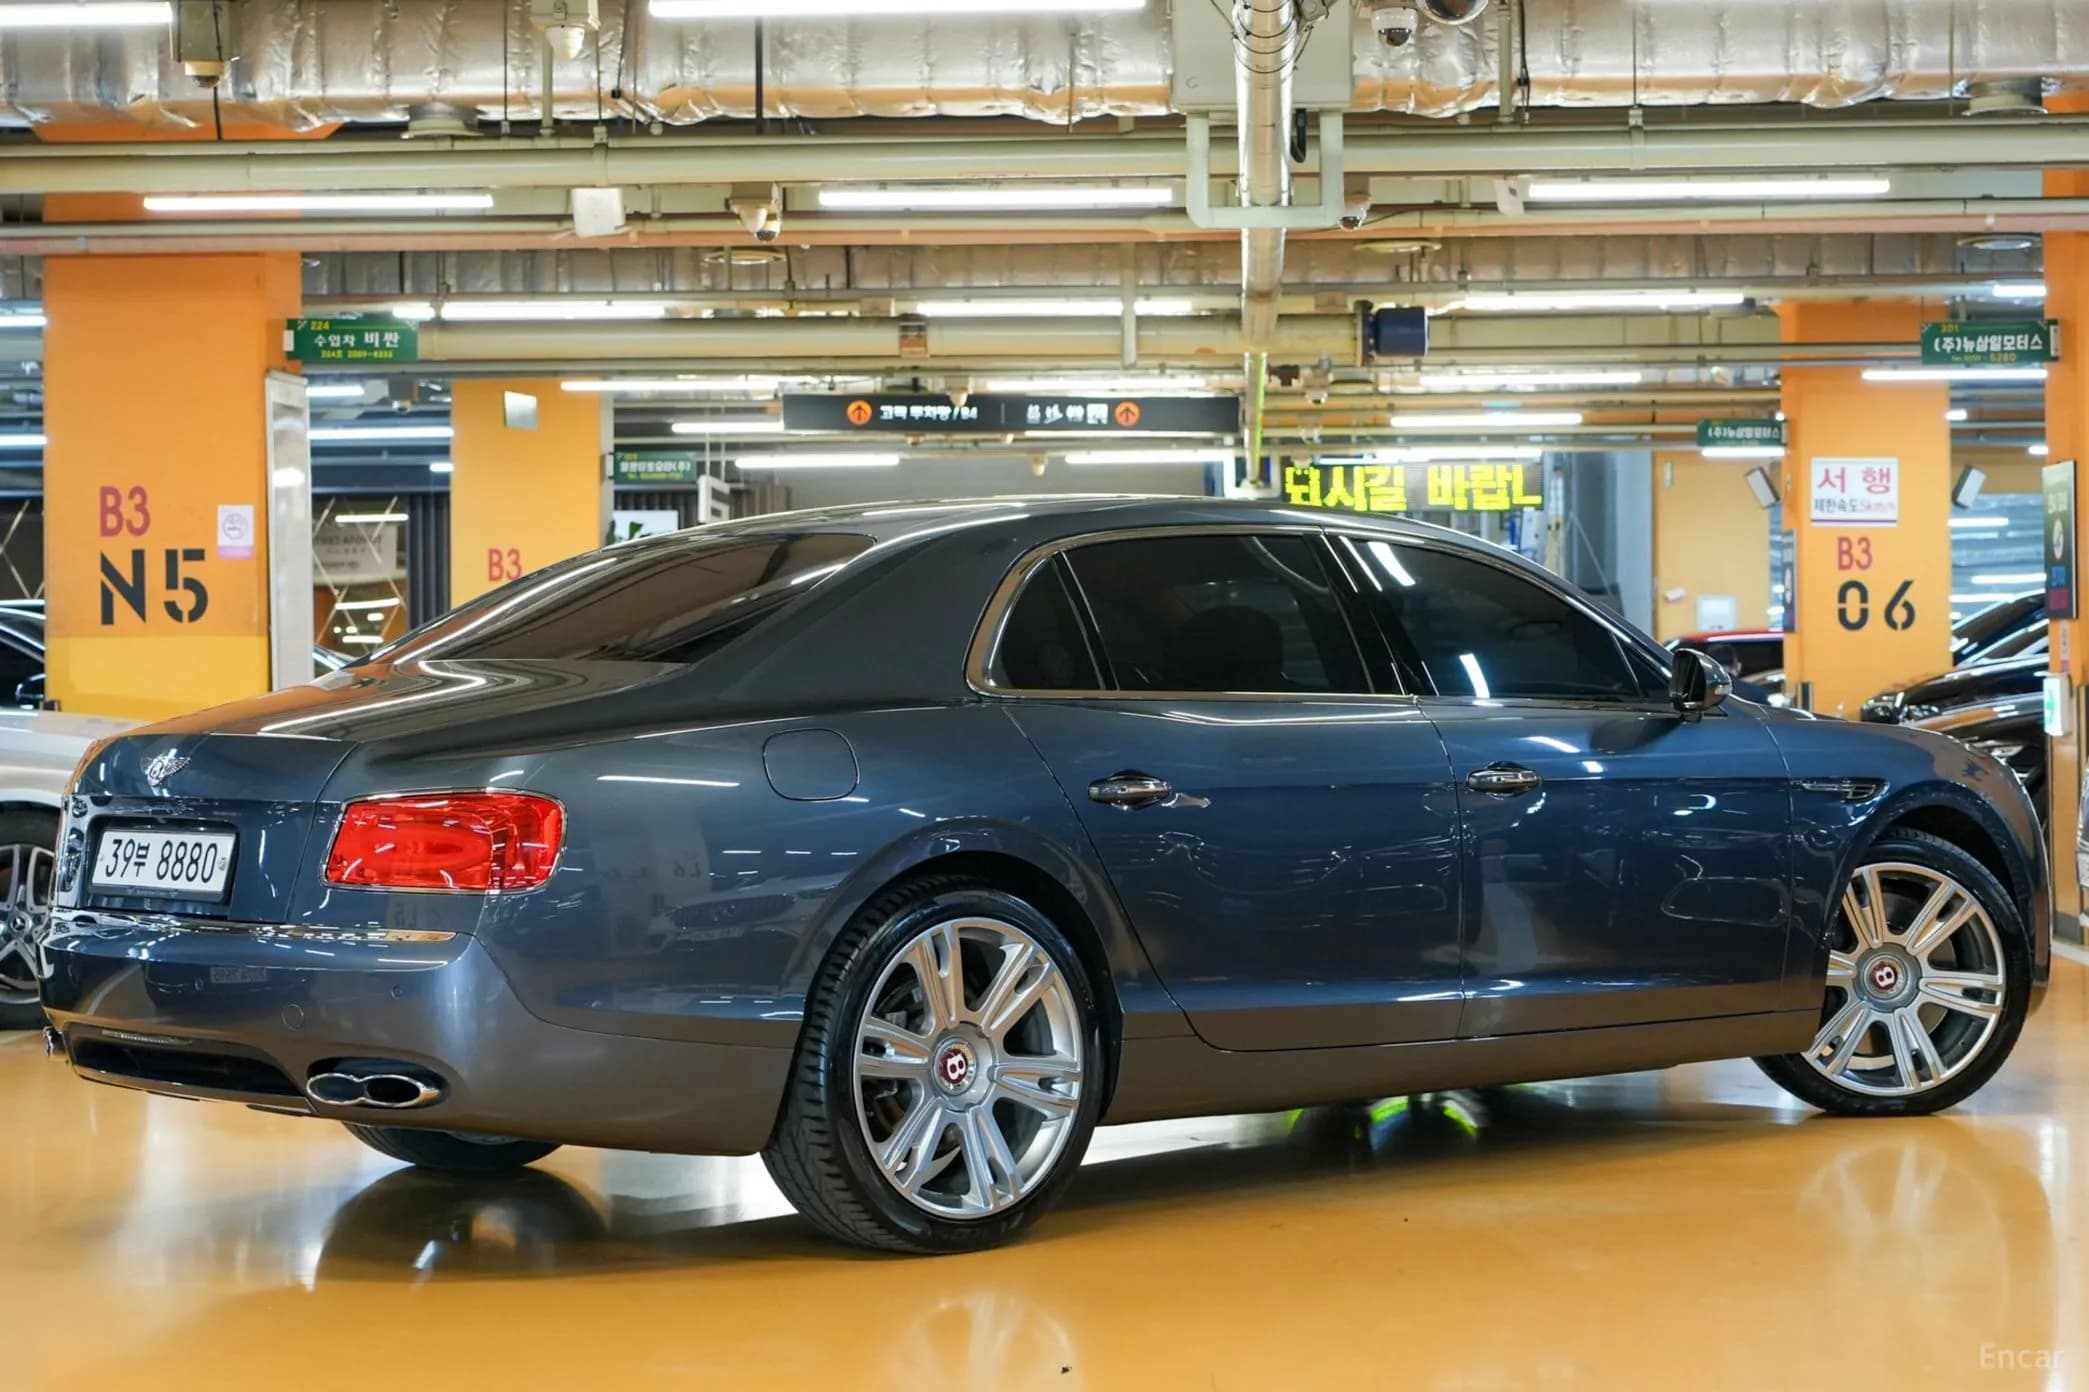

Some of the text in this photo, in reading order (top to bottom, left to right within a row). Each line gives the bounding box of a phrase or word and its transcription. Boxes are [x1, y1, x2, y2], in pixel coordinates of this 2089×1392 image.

[315, 334, 356, 348] 수입차
[1934, 333, 2043, 353] (주)뉴삼일모터스
[100, 486, 150, 537] B3
[488, 548, 522, 581] B3
[1837, 536, 1873, 571] B3
[105, 838, 218, 884] 39부 8880
